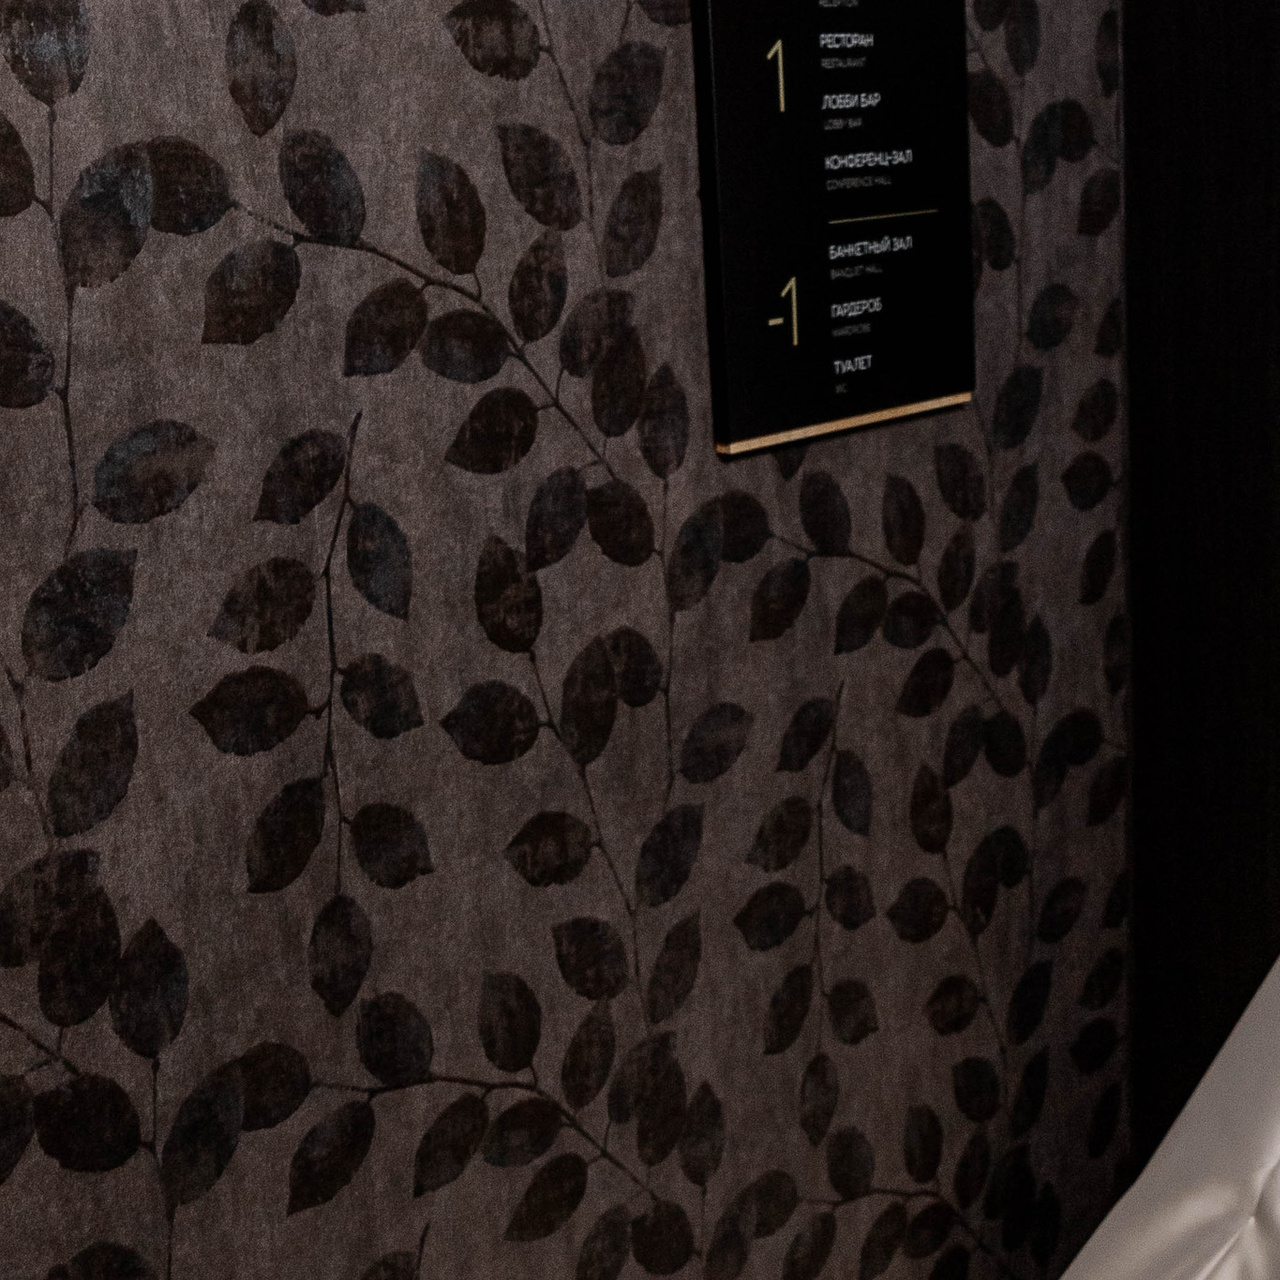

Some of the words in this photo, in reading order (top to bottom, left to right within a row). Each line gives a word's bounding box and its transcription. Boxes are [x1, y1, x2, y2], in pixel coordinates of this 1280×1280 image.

[820, 33, 874, 49] РЕСТОРАН
[766, 39, 786, 113] 1
[821, 94, 860, 110] ЛОББИ
[860, 92, 882, 108] БАР
[824, 149, 913, 170] КОНФЕРЕНЦ-ЗАЛ
[829, 235, 891, 260] БАНКЕТНЫЙ
[830, 297, 883, 318] ГАРДЕРОБ
[833, 354, 872, 375] ТУАЛЕТ
